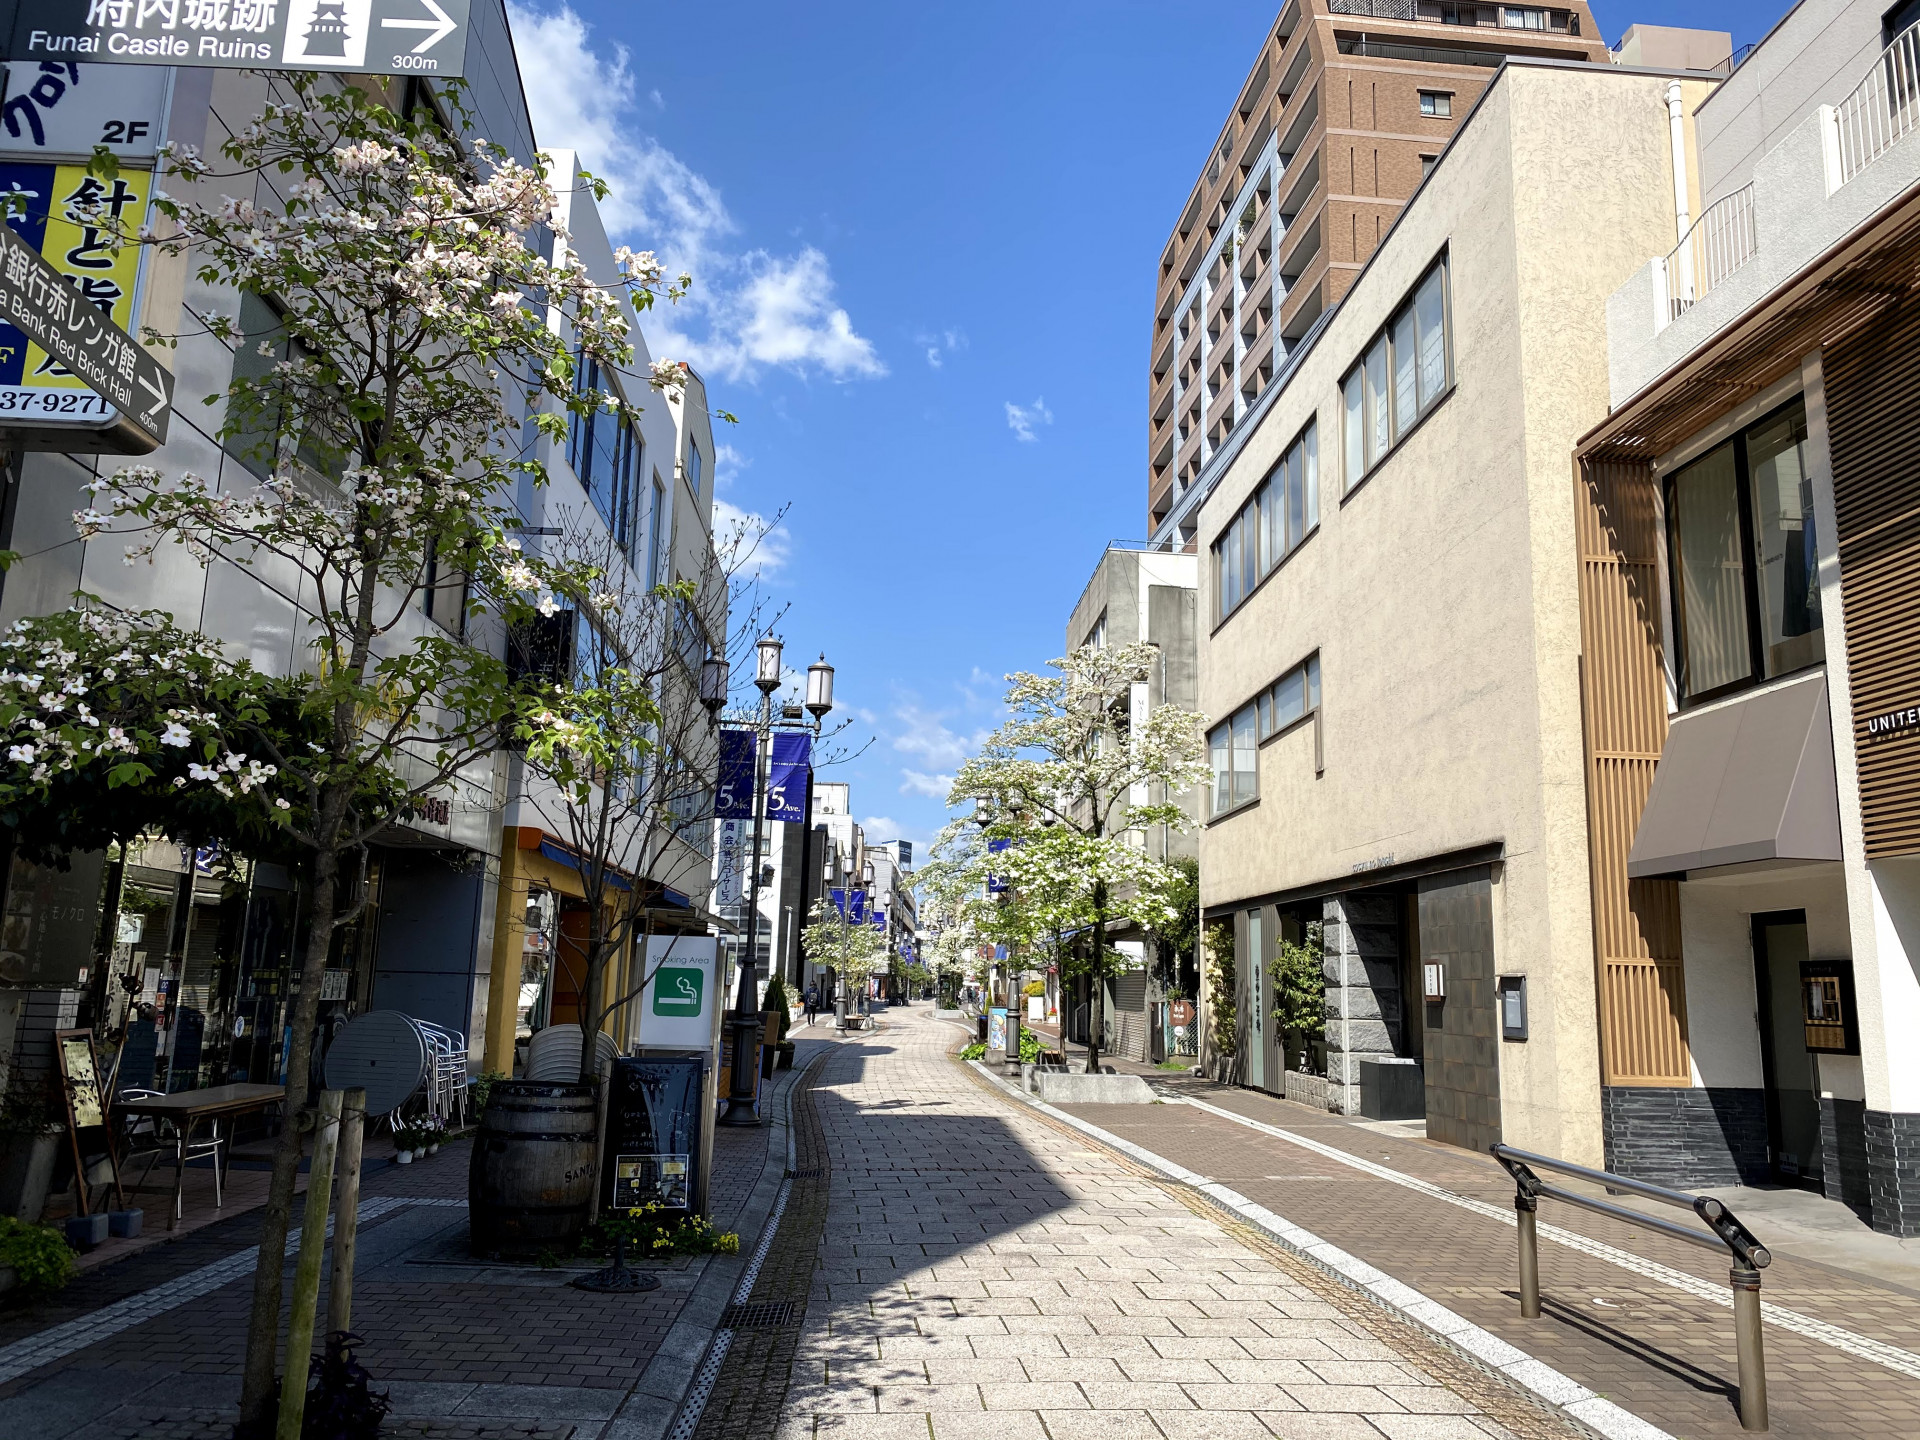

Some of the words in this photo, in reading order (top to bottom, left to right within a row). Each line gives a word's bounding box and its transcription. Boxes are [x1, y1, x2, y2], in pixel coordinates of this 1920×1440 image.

[85, 0, 278, 33] 府内城跡
[28, 30, 101, 53] Funai
[107, 32, 190, 57] Castle
[197, 36, 272, 60] Ruins
[391, 55, 438, 71] 300m
[100, 120, 150, 144] 2F
[11, 292, 47, 339] Bank
[49, 325, 75, 363] Red
[77, 349, 107, 389] Brick
[109, 377, 132, 408] Hall
[139, 410, 159, 434] 400m
[716, 781, 735, 811] 5
[768, 786, 787, 812] 5
[783, 803, 801, 813] Ave.
[51, 906, 85, 922] モノクロ
[651, 954, 687, 967] Smoking
[689, 955, 710, 965] Area
